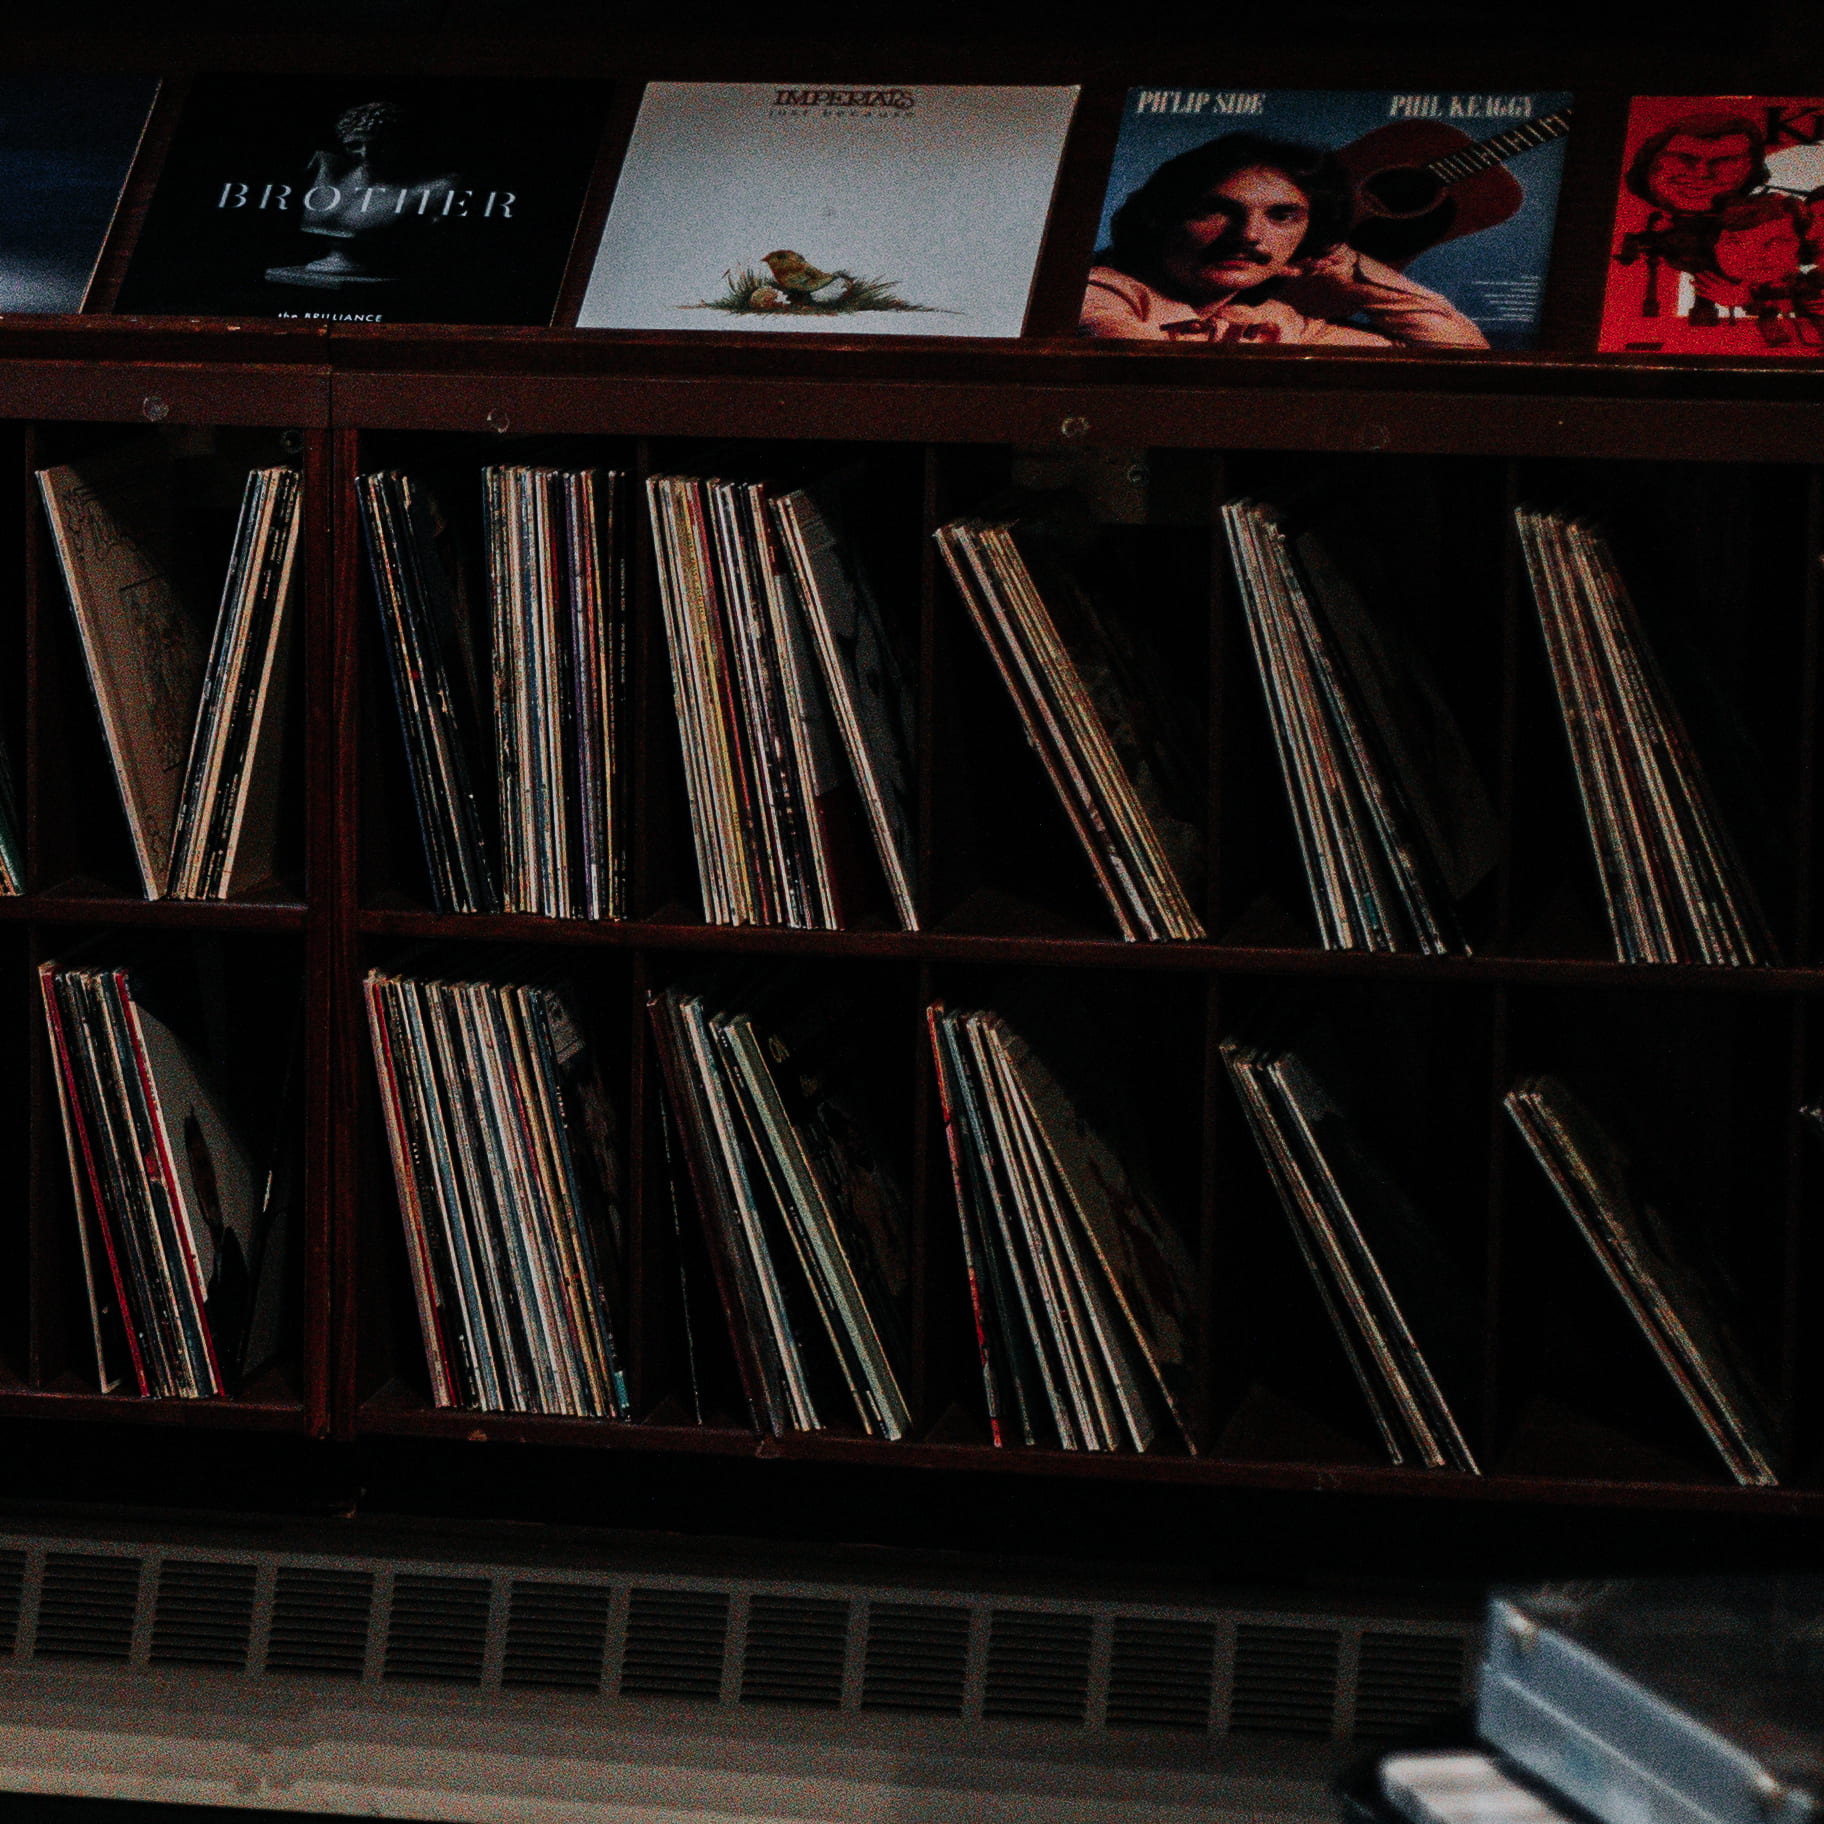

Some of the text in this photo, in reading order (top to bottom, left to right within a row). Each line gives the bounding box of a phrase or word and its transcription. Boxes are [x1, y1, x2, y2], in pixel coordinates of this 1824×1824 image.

[775, 89, 914, 110] IMPERIALS
[1389, 95, 1442, 117] PHIL
[217, 181, 518, 219] BROTHER
